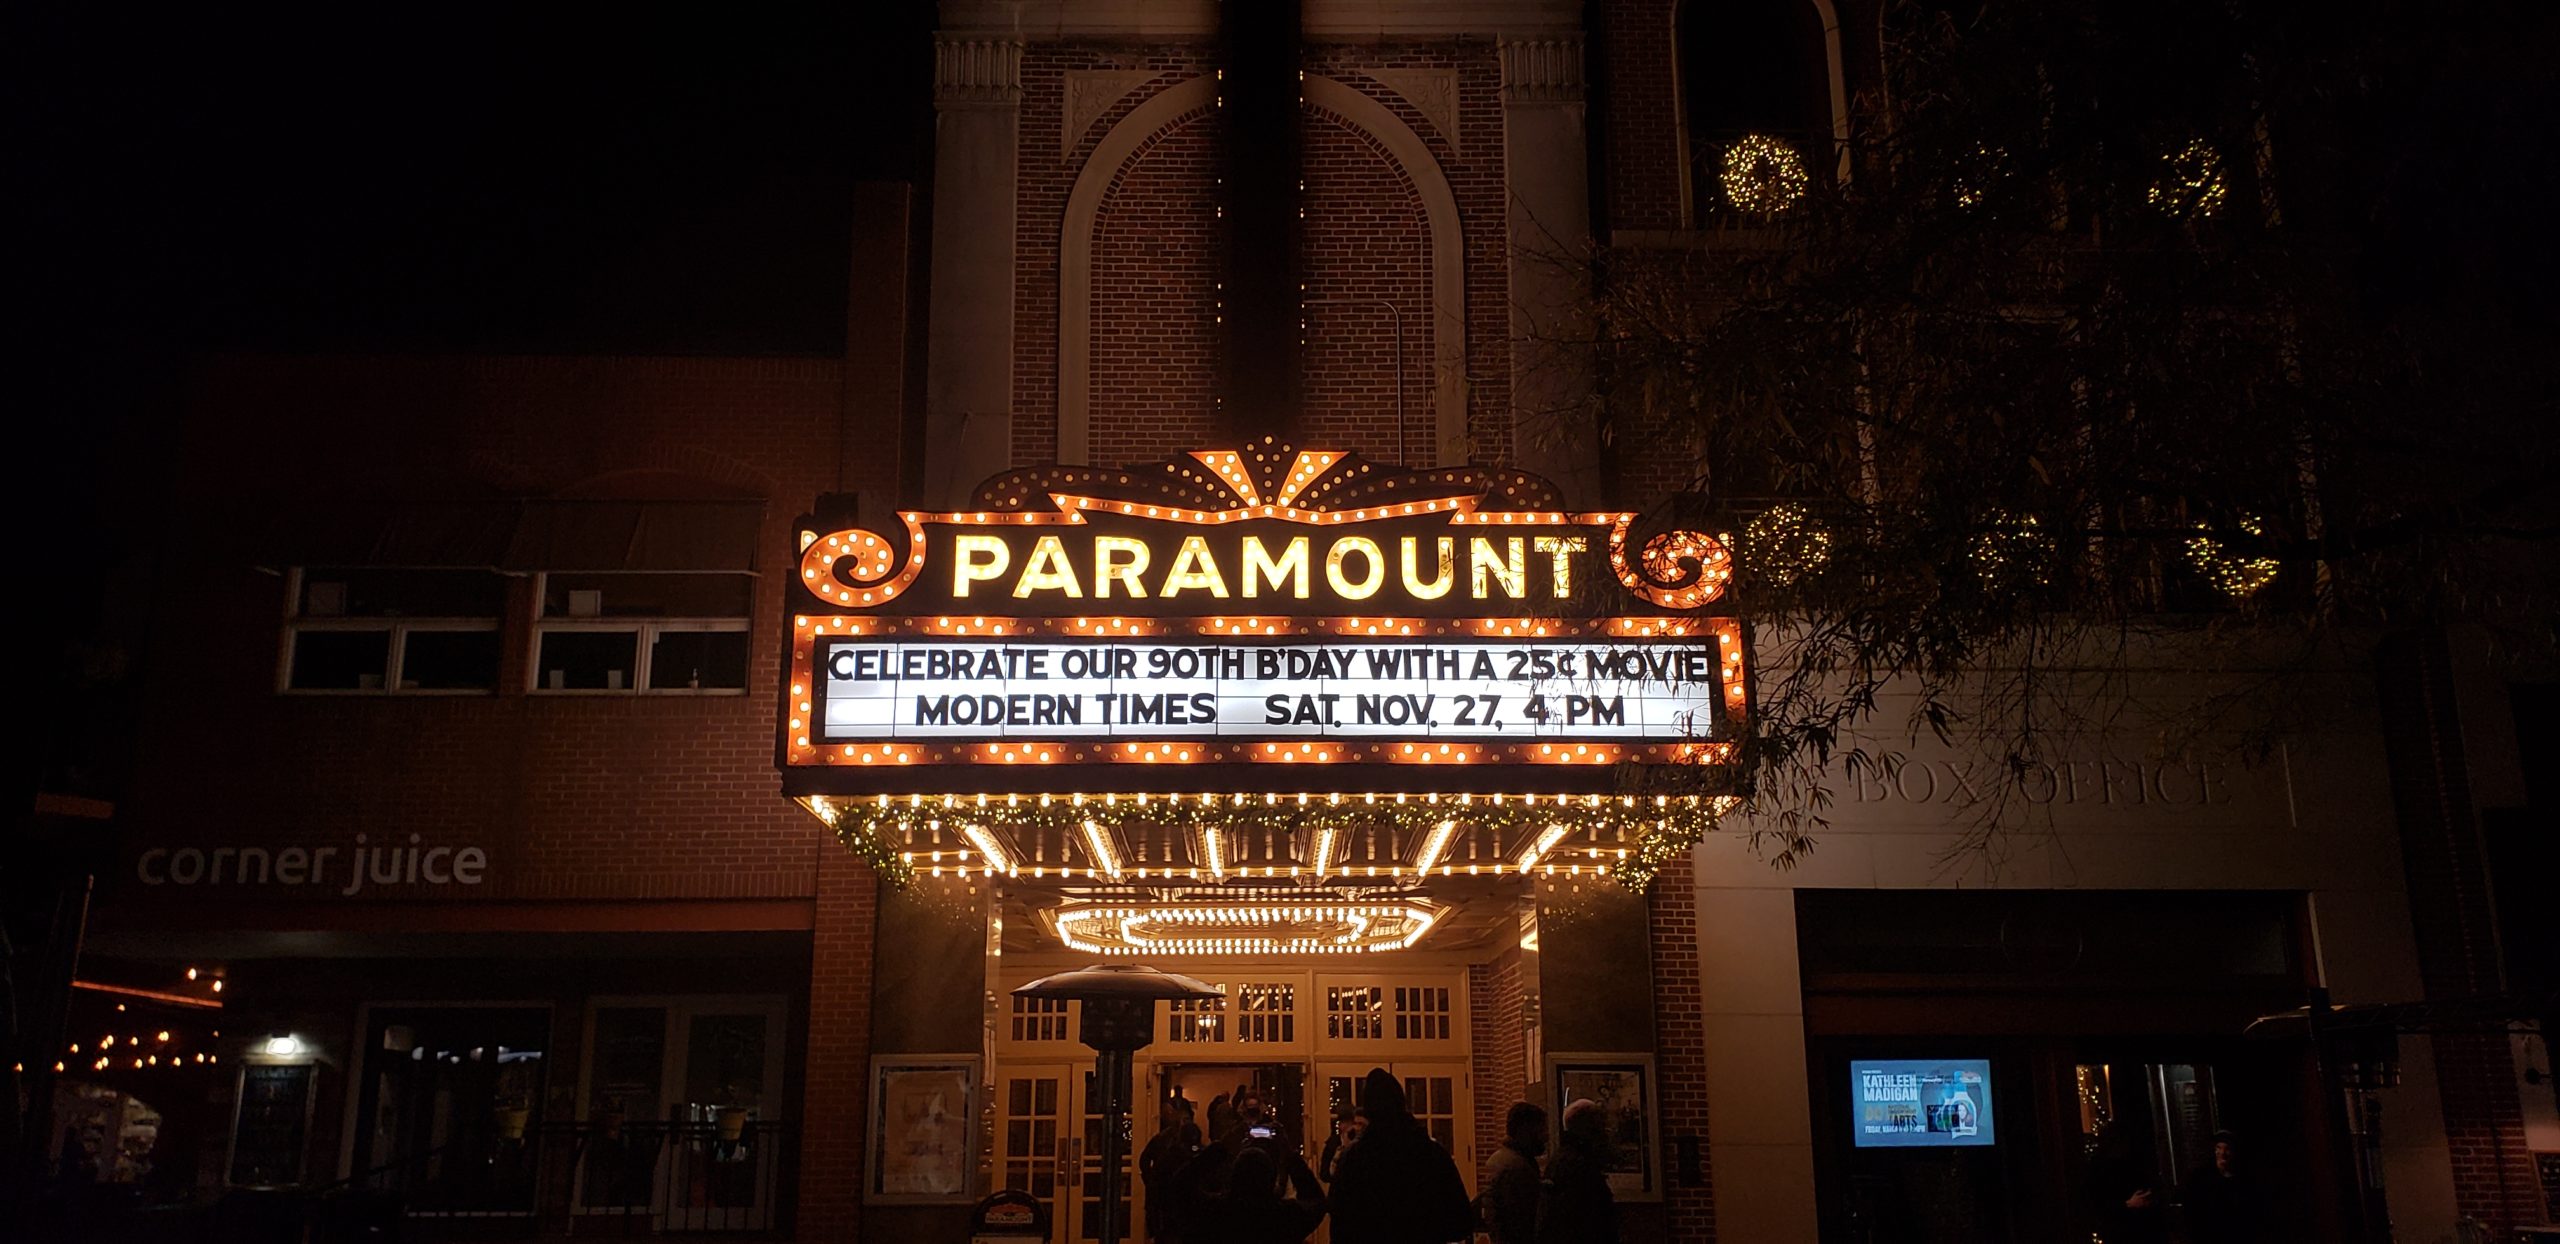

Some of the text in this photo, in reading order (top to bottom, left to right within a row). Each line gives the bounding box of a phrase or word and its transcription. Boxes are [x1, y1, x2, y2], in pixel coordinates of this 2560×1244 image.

[953, 536, 1588, 600] PARAMOUNT
[828, 648, 1049, 681] CELEBRATE
[1061, 648, 1137, 681] OUR
[1256, 648, 1358, 681] B'DAY
[1366, 649, 1460, 681] WITH
[1470, 649, 1498, 681] A
[1506, 650, 1577, 681] 25¢
[1586, 651, 1709, 682] MOVIE
[916, 693, 1625, 731] MODERN TIMES SAT. NOV. 27, 4 PM
[1857, 759, 2232, 804] BOX OFFICE
[137, 832, 488, 897] corner juice
[1863, 1074, 1917, 1088] KATHLEEN
[1864, 1087, 1918, 1102] MADIGAN
